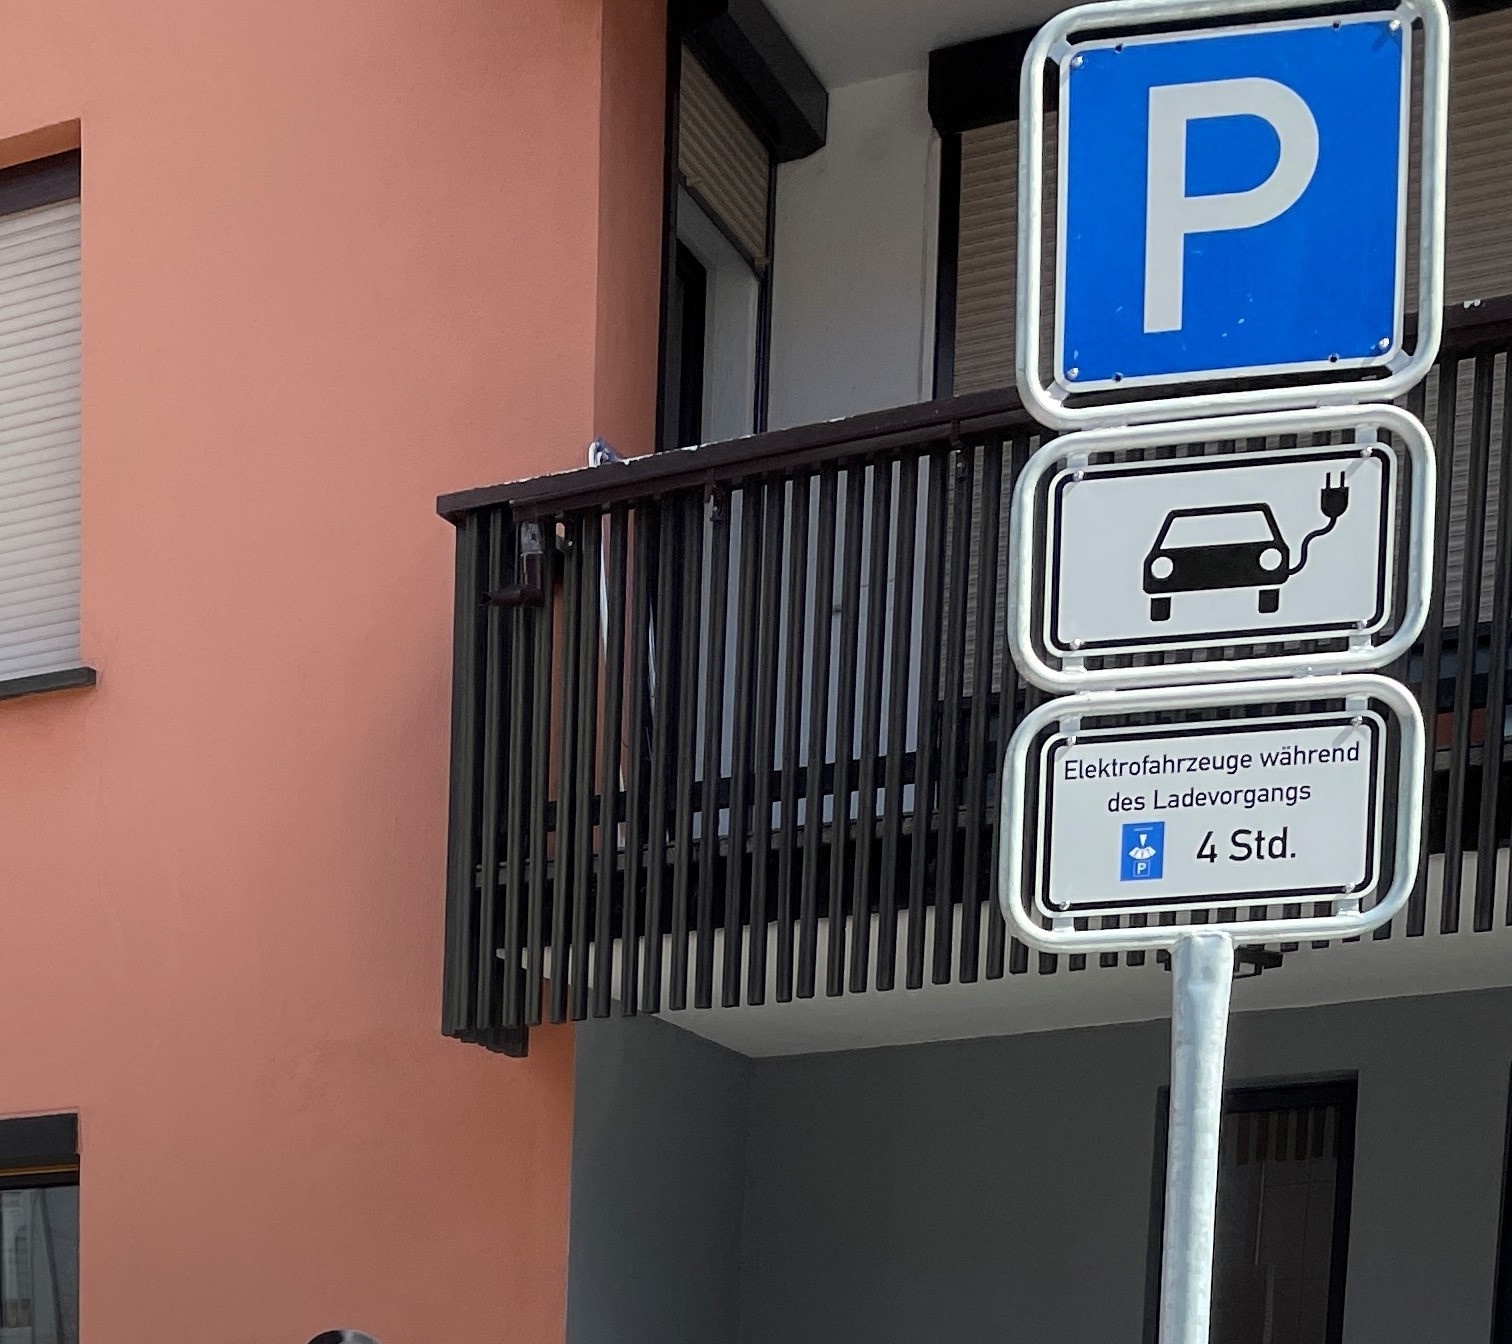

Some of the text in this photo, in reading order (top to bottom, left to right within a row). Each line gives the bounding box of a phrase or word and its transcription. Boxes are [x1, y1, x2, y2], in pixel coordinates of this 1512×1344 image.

[1144, 77, 1319, 334] P
[1064, 741, 1360, 780] Elektrofahrzeuge während
[1107, 784, 1311, 812] des Ladevorgangs
[1196, 826, 1296, 864] 4 Std.
